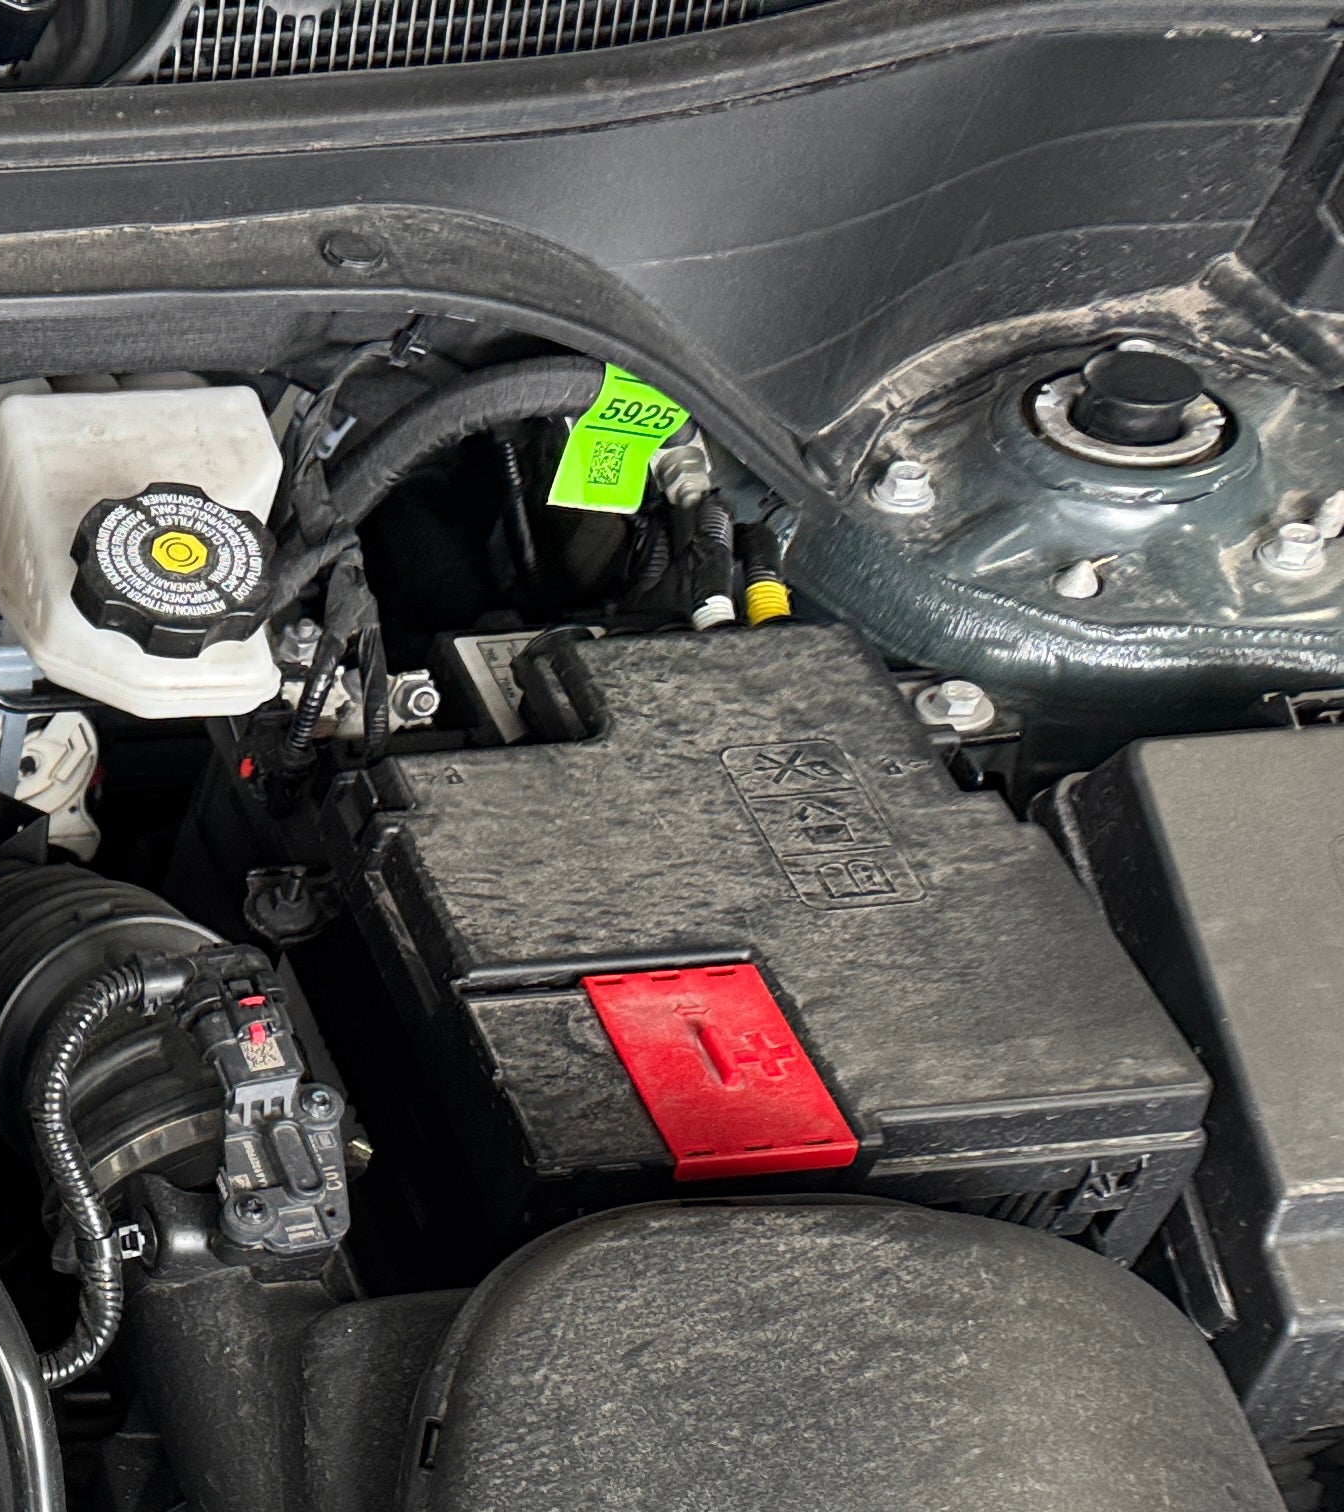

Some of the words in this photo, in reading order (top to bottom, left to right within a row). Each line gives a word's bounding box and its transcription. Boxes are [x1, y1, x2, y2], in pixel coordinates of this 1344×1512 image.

[598, 397, 681, 430] 5925
[144, 503, 177, 517] ONLY
[177, 504, 200, 518] USE
[202, 499, 243, 528] SEALED
[154, 514, 194, 528] FILLER
[235, 523, 249, 533] A
[192, 519, 226, 545] CLEAN
[239, 529, 261, 555] FROM
[230, 545, 247, 578] BEFORE
[245, 556, 262, 582] FLUID
[113, 580, 131, 594] LE
[128, 576, 148, 591] DU
[139, 583, 163, 600] QUE
[148, 574, 210, 594] PROVENANT
[218, 573, 241, 593] CAP
[123, 587, 174, 616] NETTOYER
